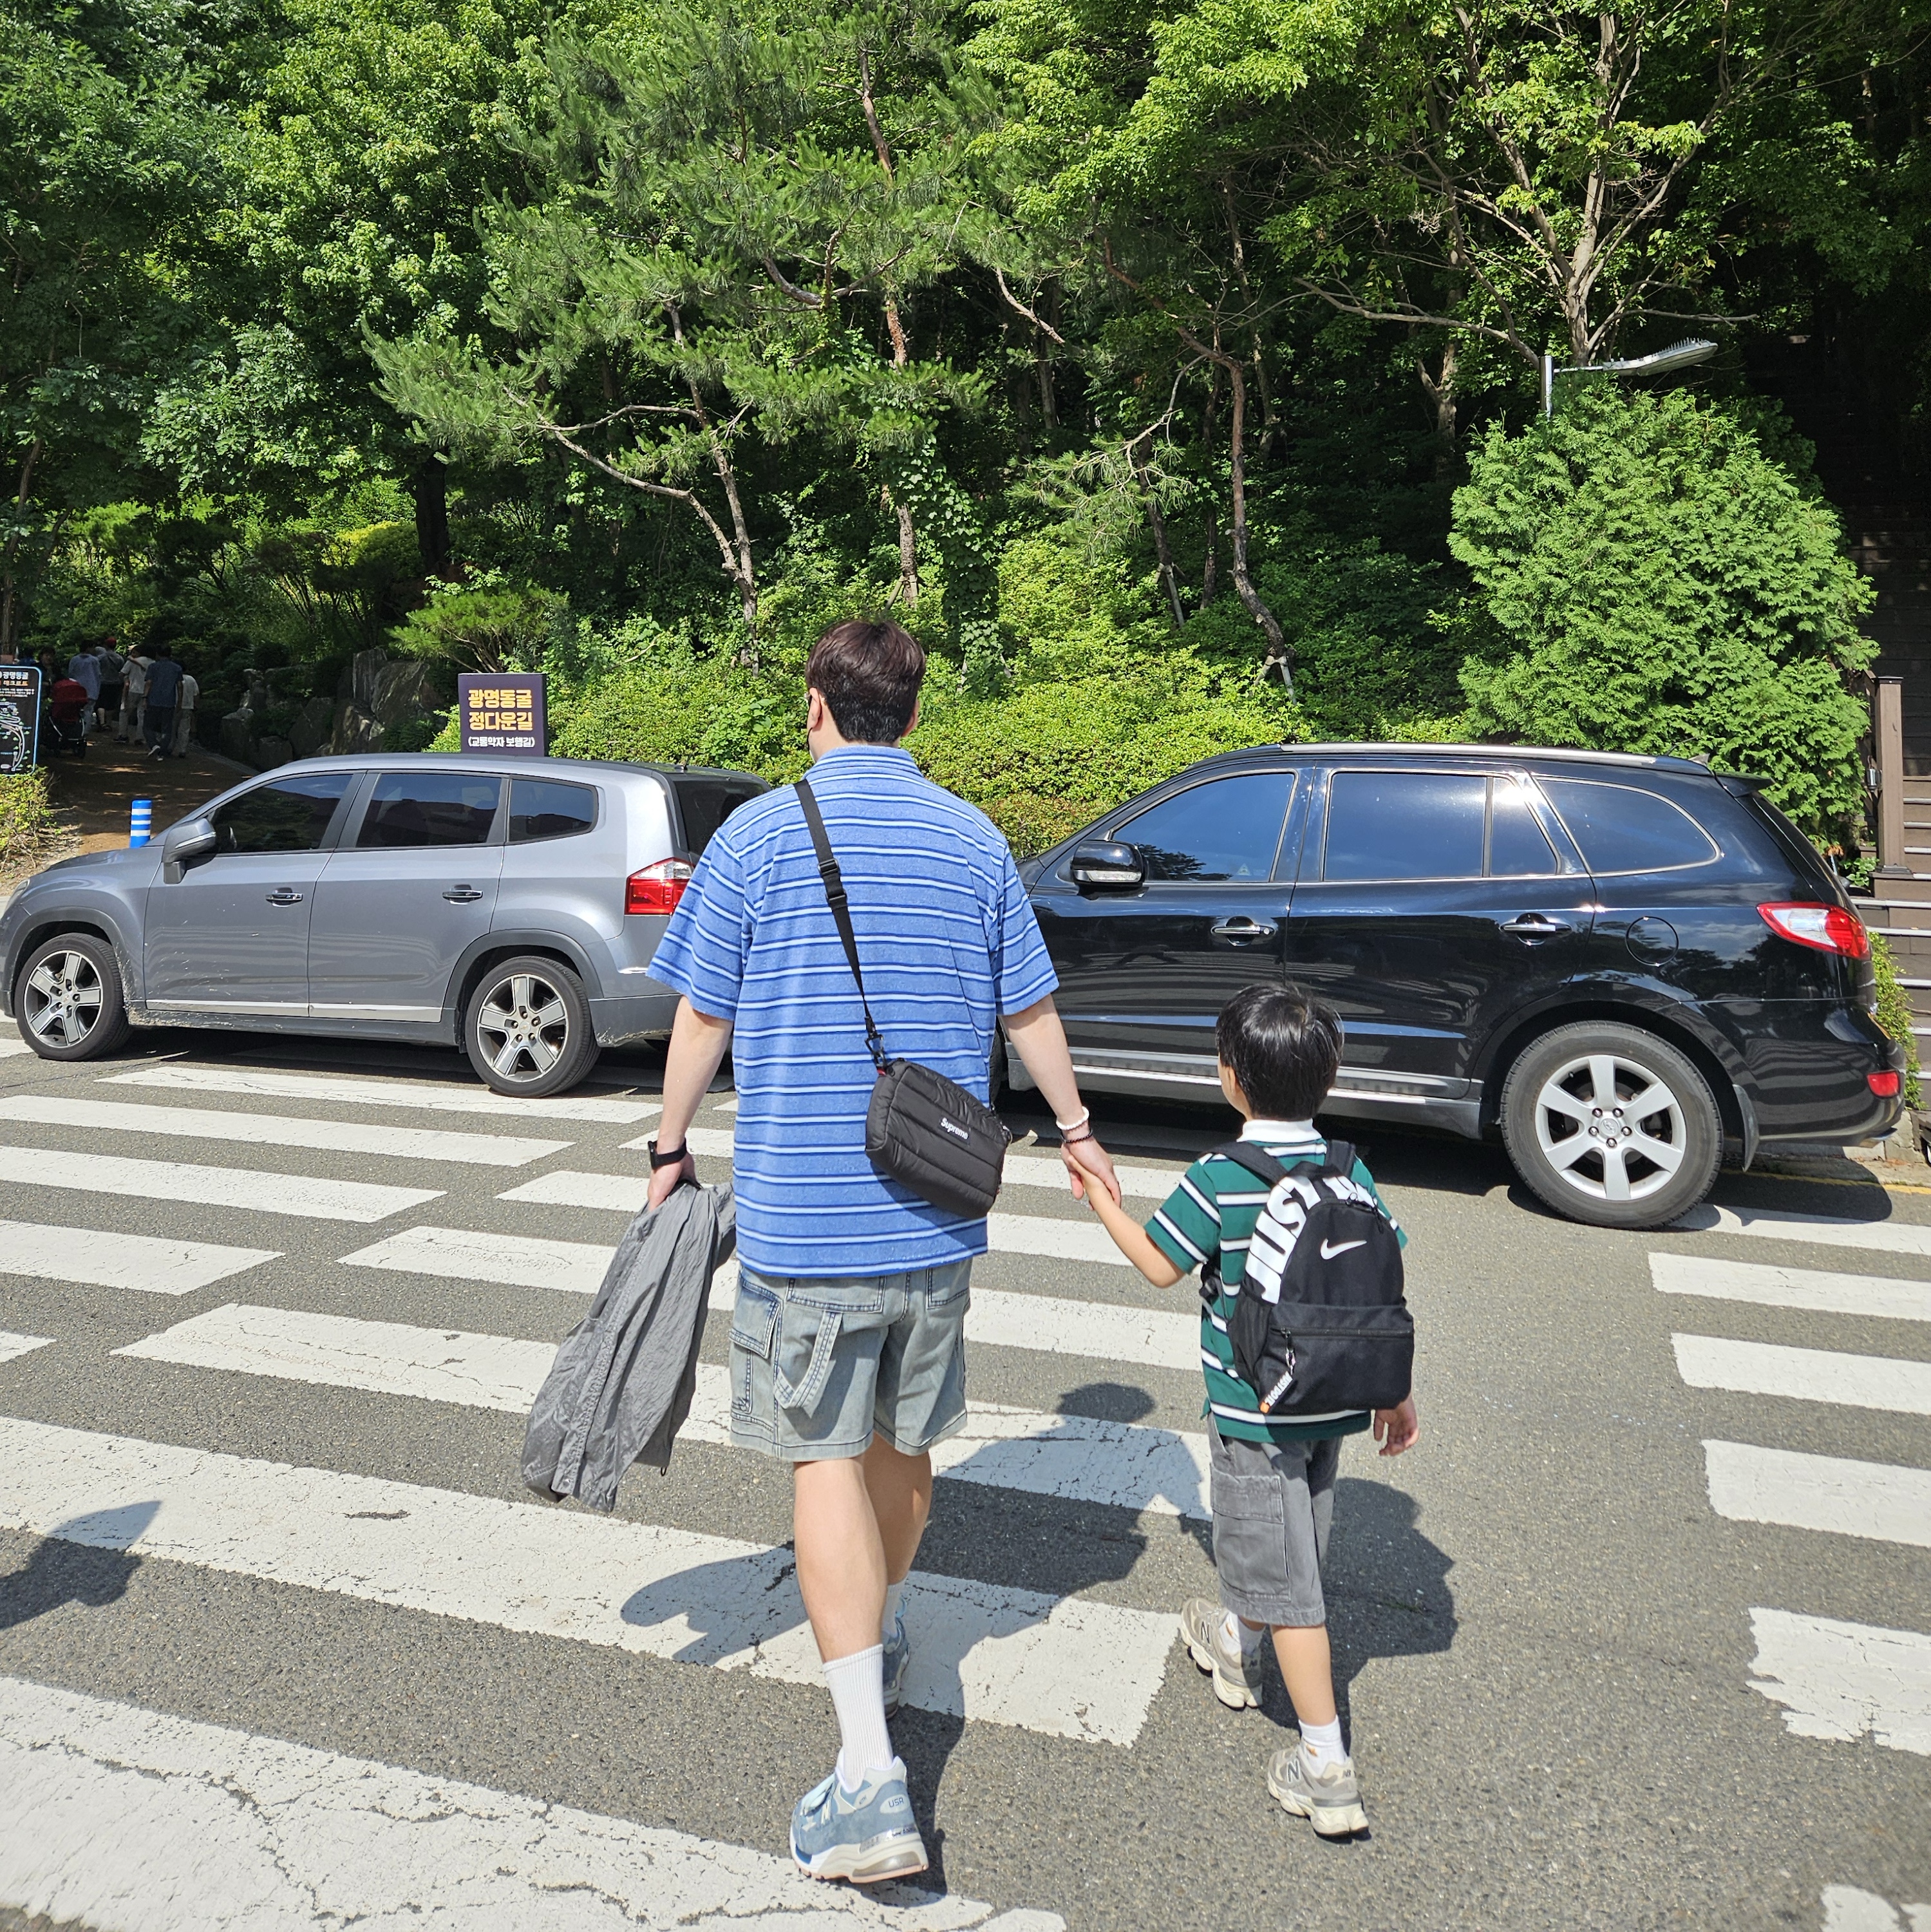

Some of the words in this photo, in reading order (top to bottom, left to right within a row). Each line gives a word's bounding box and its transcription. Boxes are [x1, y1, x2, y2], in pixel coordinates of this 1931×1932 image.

[468, 689, 532, 708] 광명동굴
[469, 712, 533, 731] 정다운길
[468, 736, 505, 747] (교통약자
[505, 737, 536, 748] 보행길)
[941, 1117, 968, 1140] Supreme
[1287, 1759, 1301, 1783] N
[889, 1797, 904, 1808] USA
